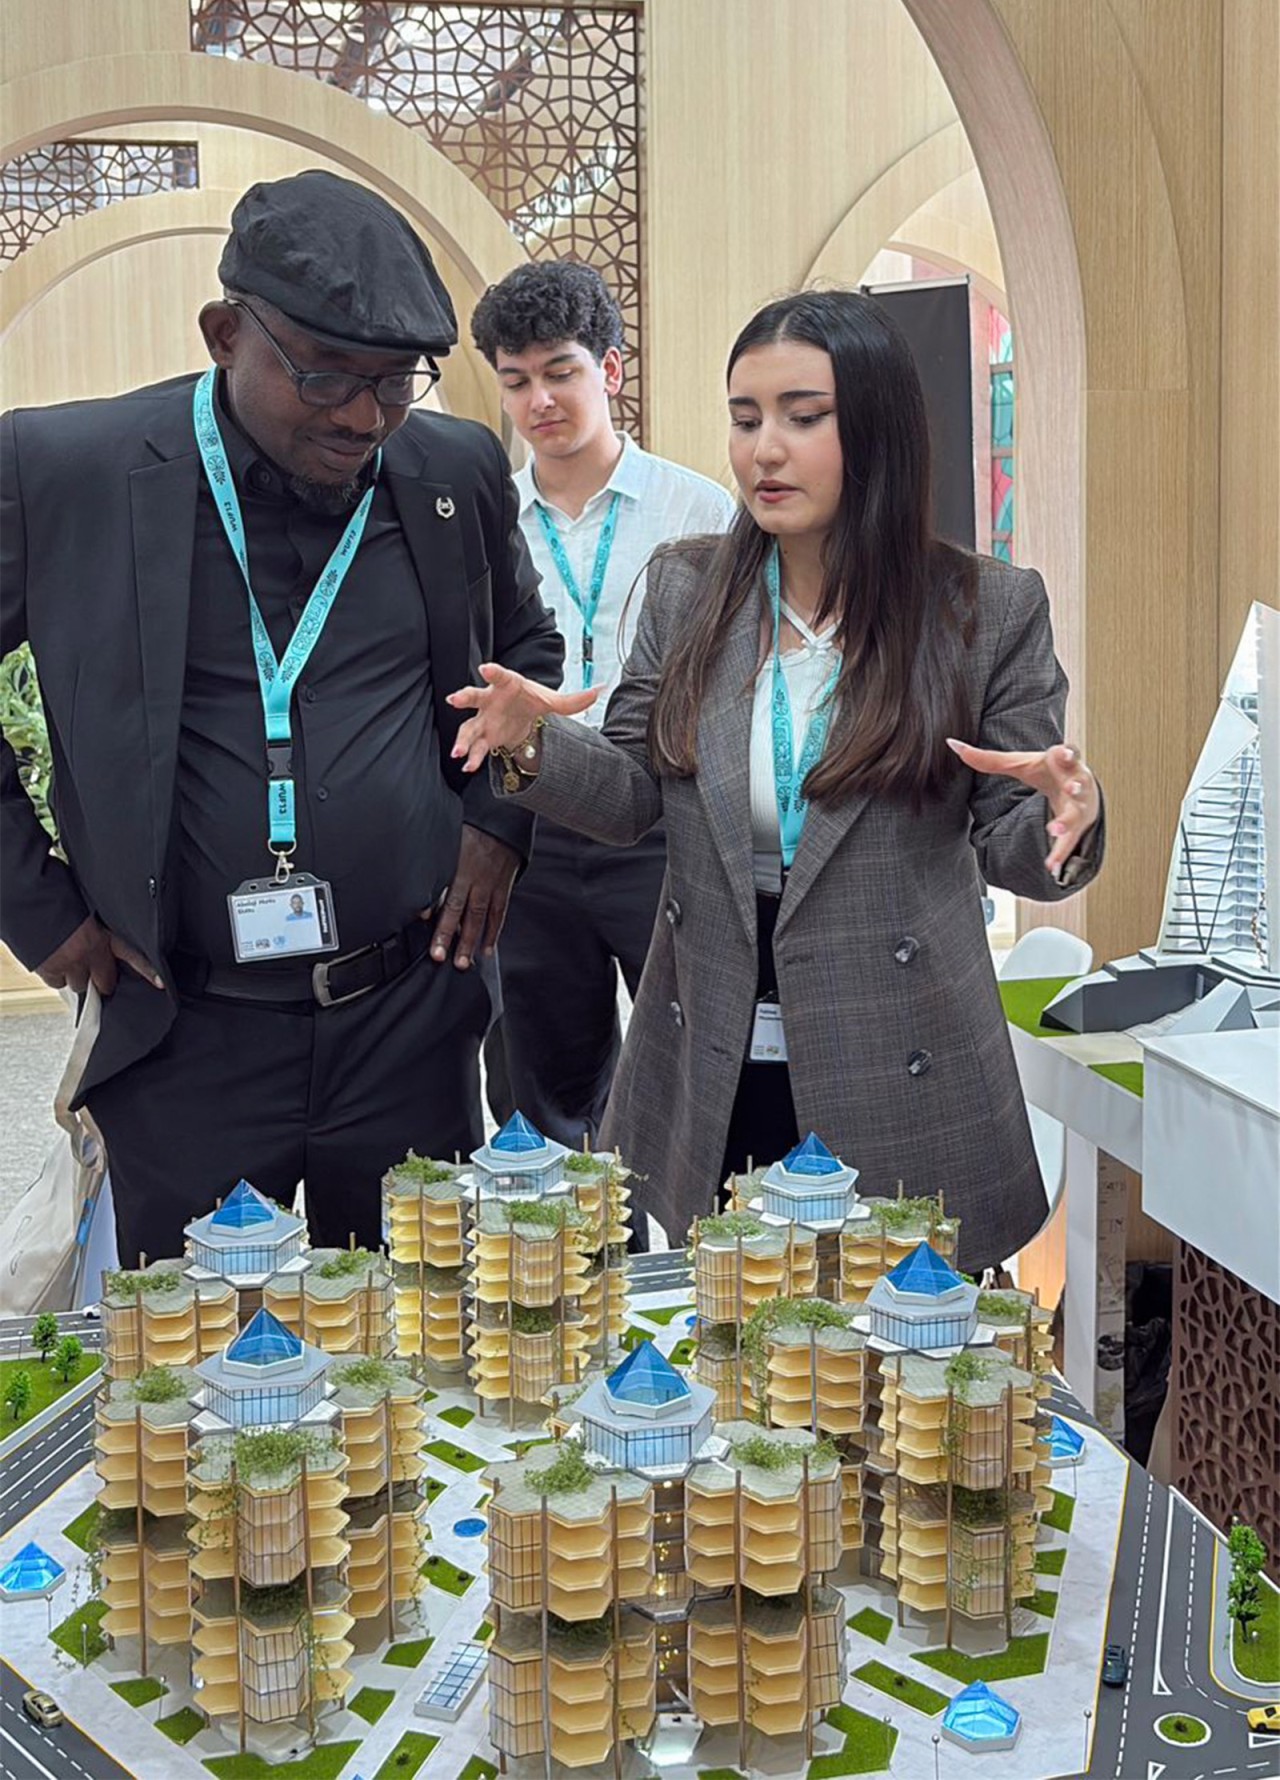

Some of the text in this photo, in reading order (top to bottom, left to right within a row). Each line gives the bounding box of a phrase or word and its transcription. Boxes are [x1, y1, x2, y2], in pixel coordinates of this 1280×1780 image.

[223, 501, 238, 532] WUF13
[341, 529, 357, 557] WUF13
[278, 782, 288, 815] WUF13
